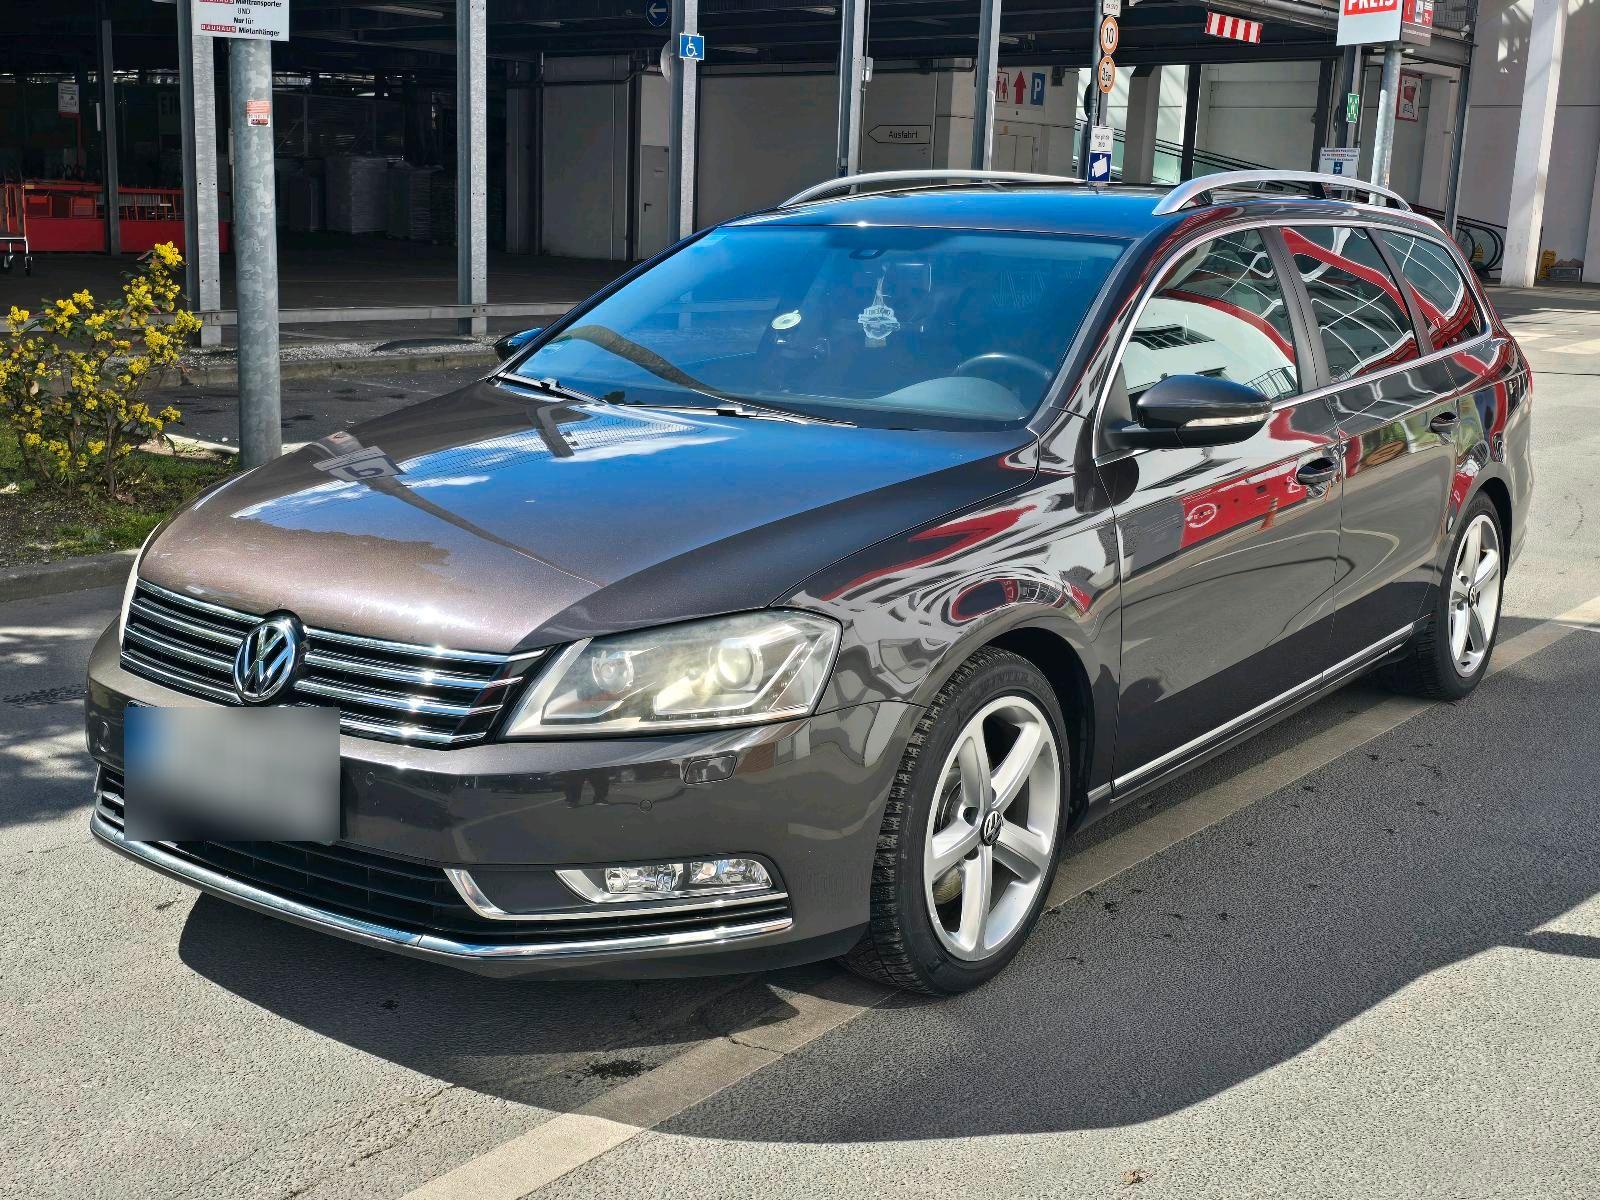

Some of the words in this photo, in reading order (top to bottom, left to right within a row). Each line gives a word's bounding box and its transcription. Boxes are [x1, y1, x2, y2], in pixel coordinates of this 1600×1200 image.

[201, 24, 236, 33] BAUHAUS
[238, 27, 280, 37] Mietanhänger
[1105, 27, 1115, 44] 10
[1033, 78, 1042, 100] P
[888, 130, 918, 139] Ausfahrt
